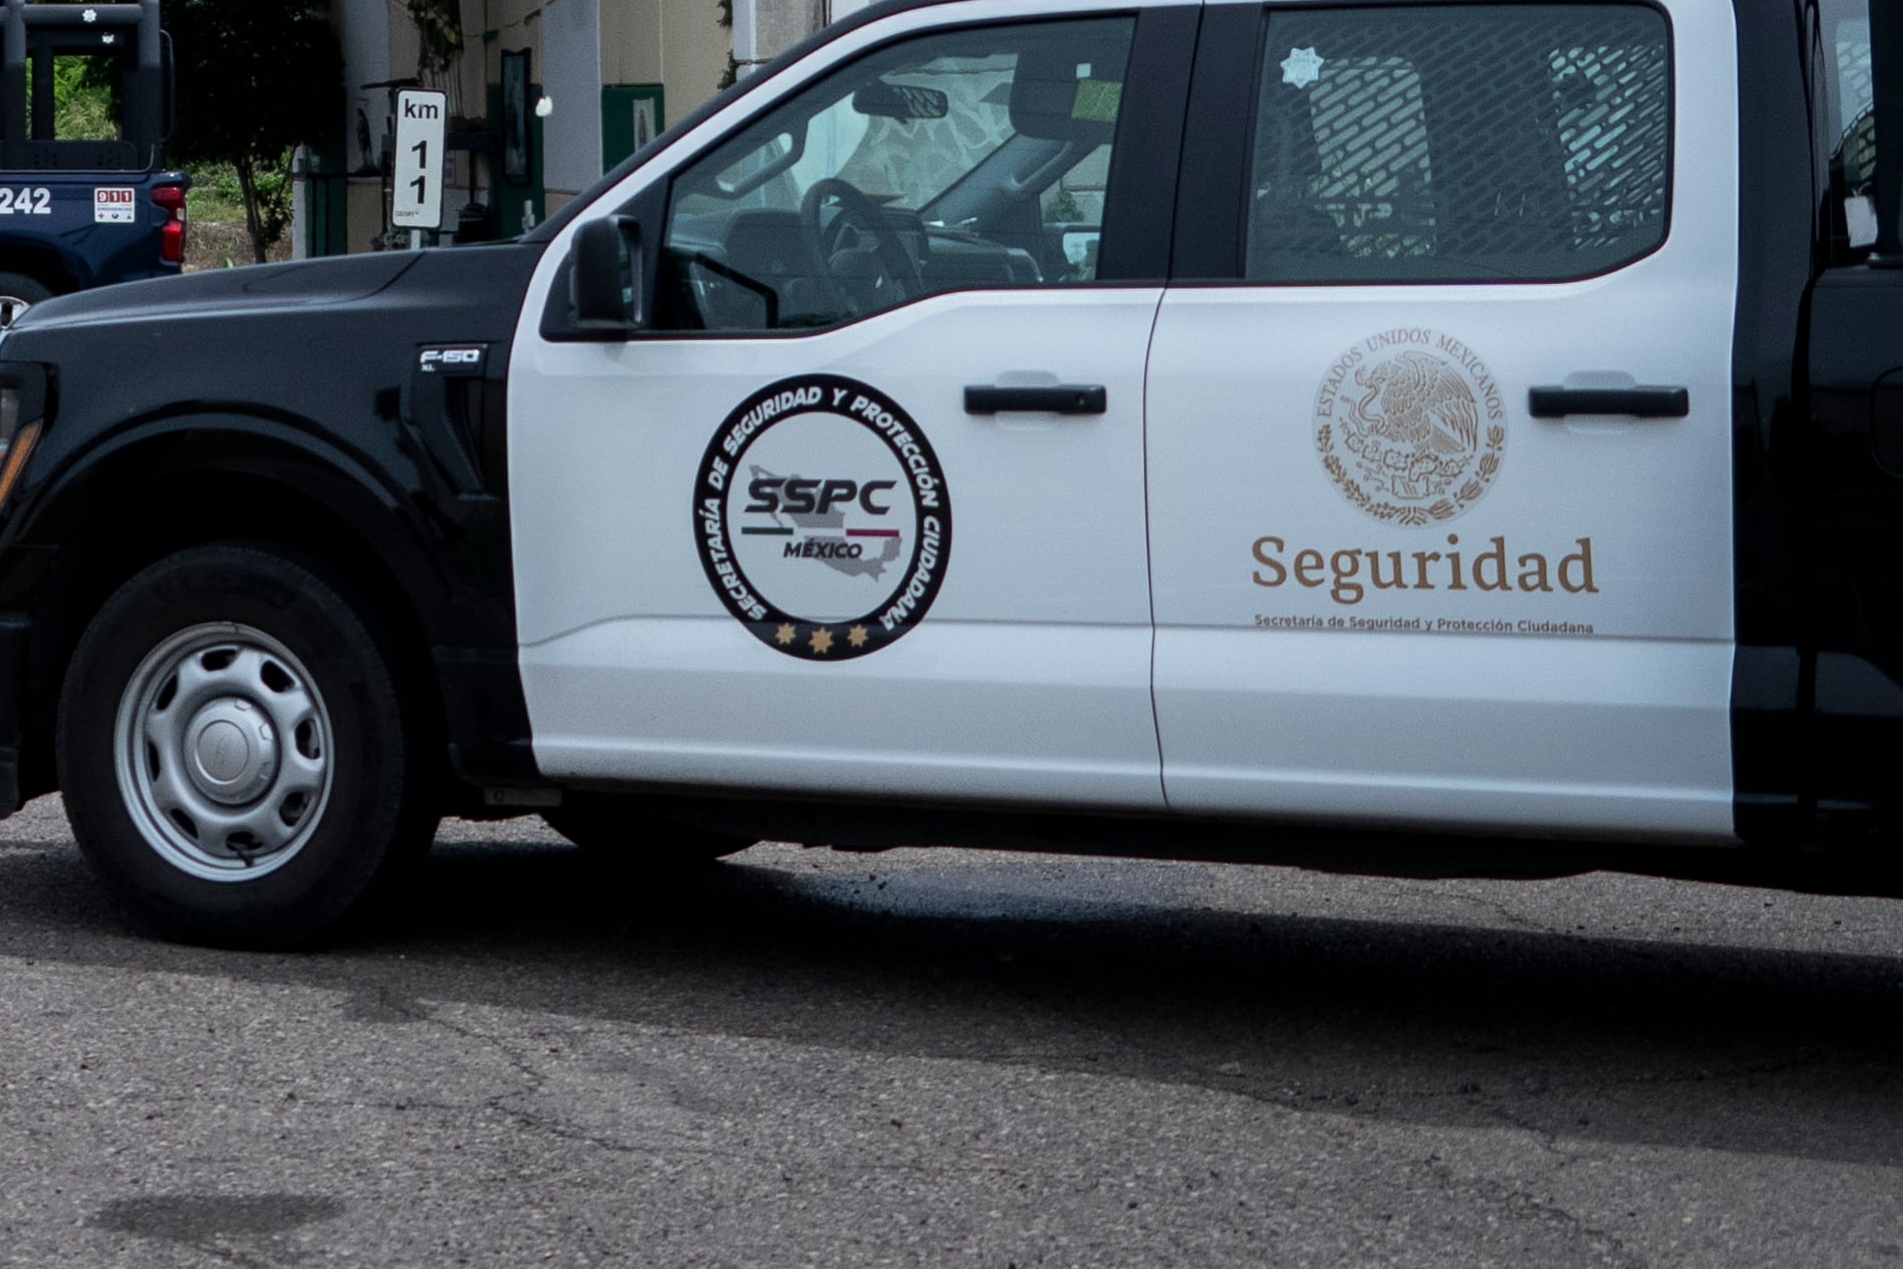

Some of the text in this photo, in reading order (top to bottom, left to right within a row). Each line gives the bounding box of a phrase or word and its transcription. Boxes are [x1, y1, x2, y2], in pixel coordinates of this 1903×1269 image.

[404, 98, 439, 120] km
[98, 191, 131, 203] 911
[420, 349, 480, 363] F-150
[1317, 327, 1503, 420] ESTADOS UNIDOS MEXICANOS
[744, 479, 898, 515] SSPC
[698, 386, 941, 631] SECRETARÍA DE SEGURIDAD Y PROTECCIÓN CIUDADANA
[783, 538, 863, 559] MÉXICO
[1251, 533, 1599, 605] Seguridad
[1254, 613, 1595, 634] Secretaría de Seguridad y Protección Ciudadana
